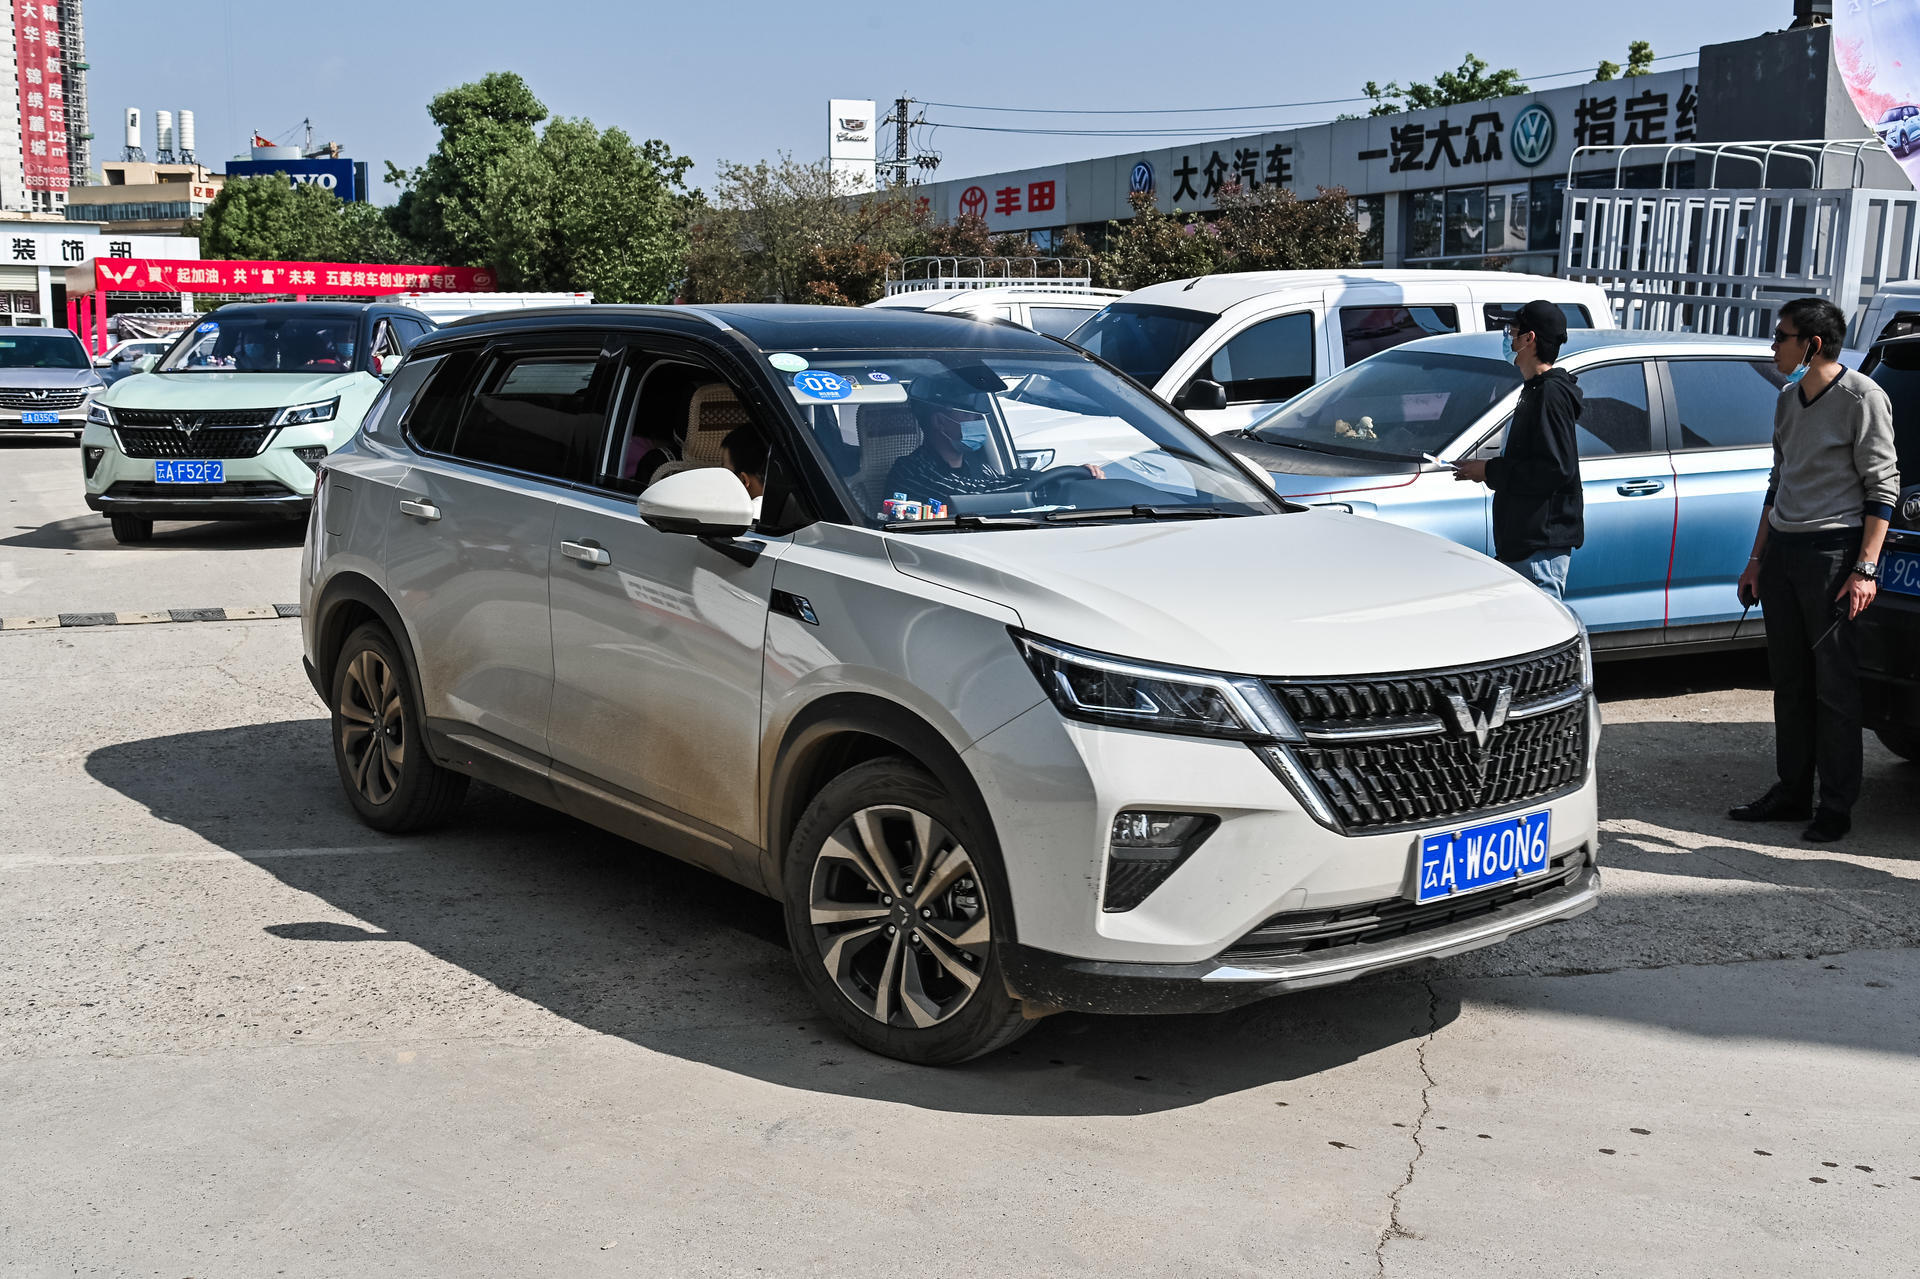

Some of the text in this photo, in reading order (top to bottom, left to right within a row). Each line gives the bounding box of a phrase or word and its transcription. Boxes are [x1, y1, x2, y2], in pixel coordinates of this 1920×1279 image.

[1358, 111, 1504, 173] 一汽大众
[1173, 144, 1293, 202] 大众汽车
[995, 180, 1055, 216] 丰田
[12, 238, 132, 260] 装饰部
[326, 271, 457, 289] 五菱货车创业致富专区
[804, 377, 841, 391] 08
[157, 463, 222, 480] 云A·F52F2
[1424, 822, 1545, 889] 云A·W60N6
